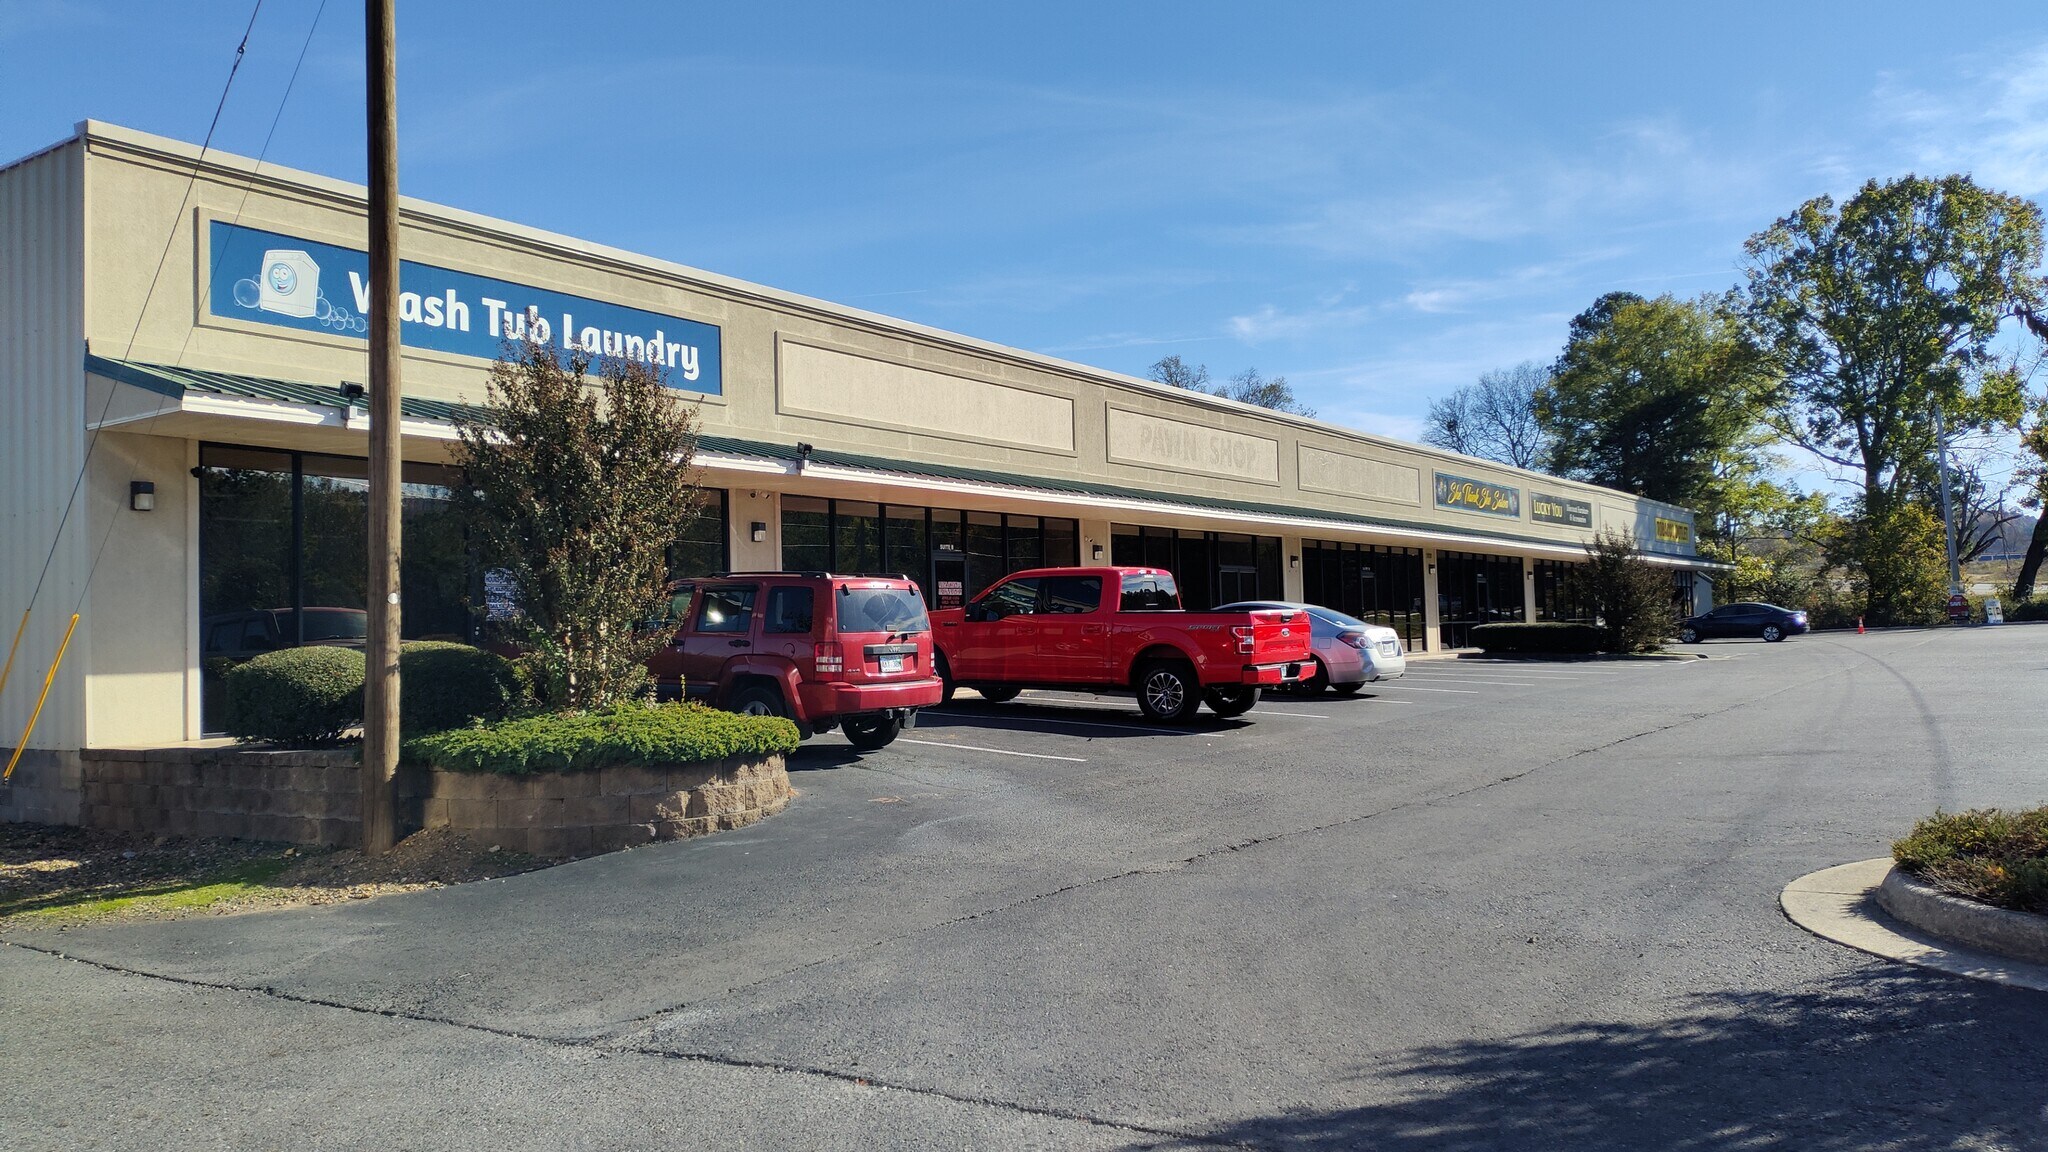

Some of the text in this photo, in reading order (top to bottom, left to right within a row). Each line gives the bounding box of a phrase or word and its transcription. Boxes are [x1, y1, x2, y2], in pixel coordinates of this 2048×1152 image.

[481, 297, 551, 345] Tub
[563, 313, 700, 381] Laundry
[1209, 436, 1258, 471] SHOP
[1551, 503, 1563, 517] YOU
